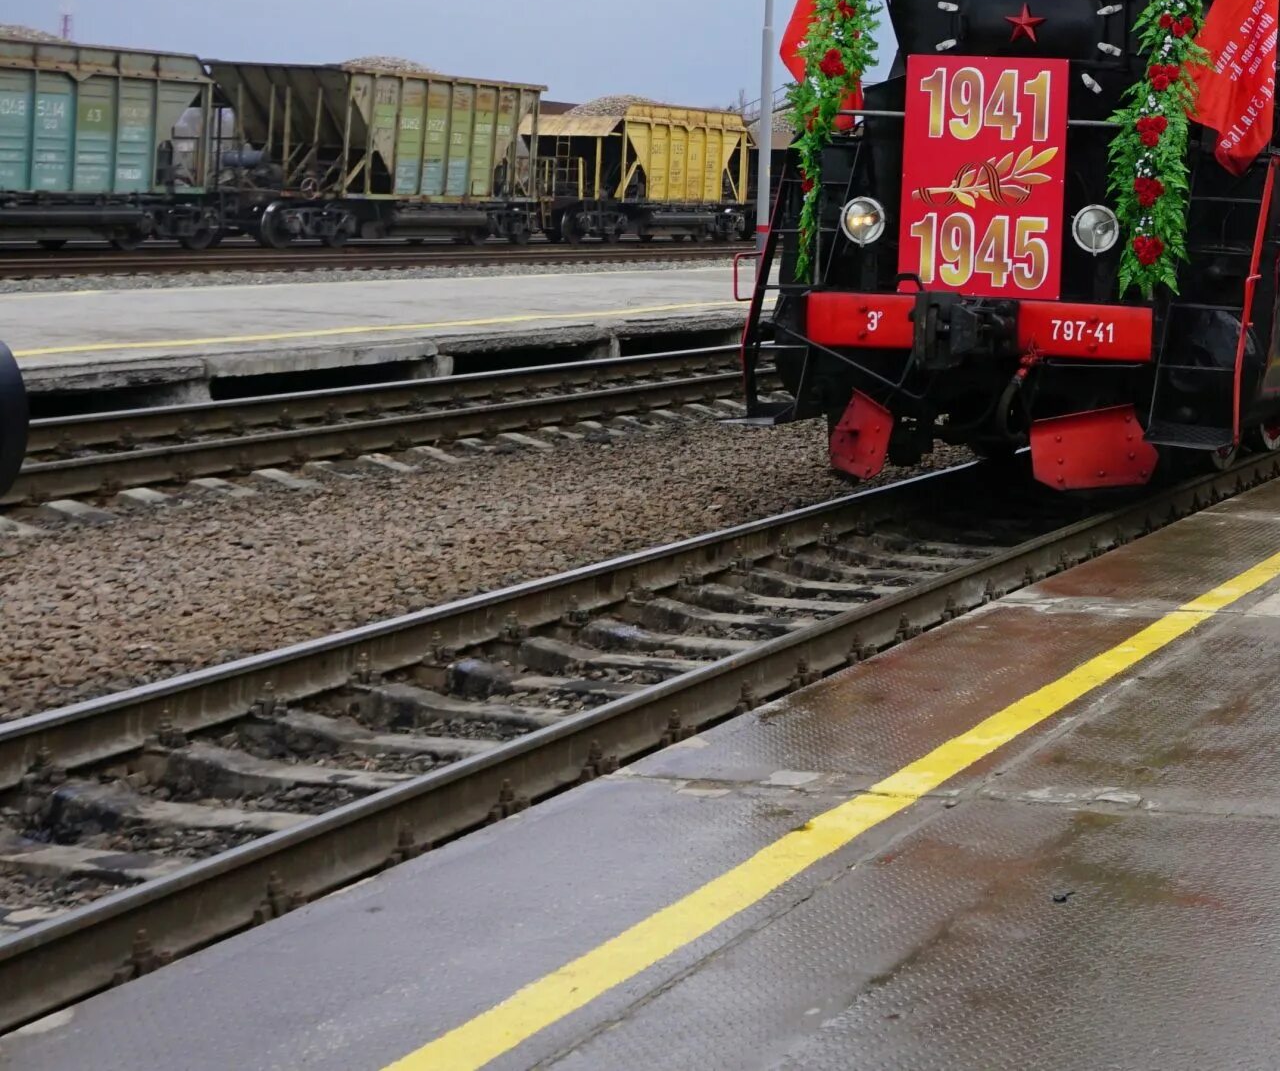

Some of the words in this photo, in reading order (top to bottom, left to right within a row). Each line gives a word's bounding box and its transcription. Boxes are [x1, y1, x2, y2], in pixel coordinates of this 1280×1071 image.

[919, 66, 1051, 142] 1941
[910, 211, 1049, 290] 1945
[1051, 319, 1114, 343] 797-41
